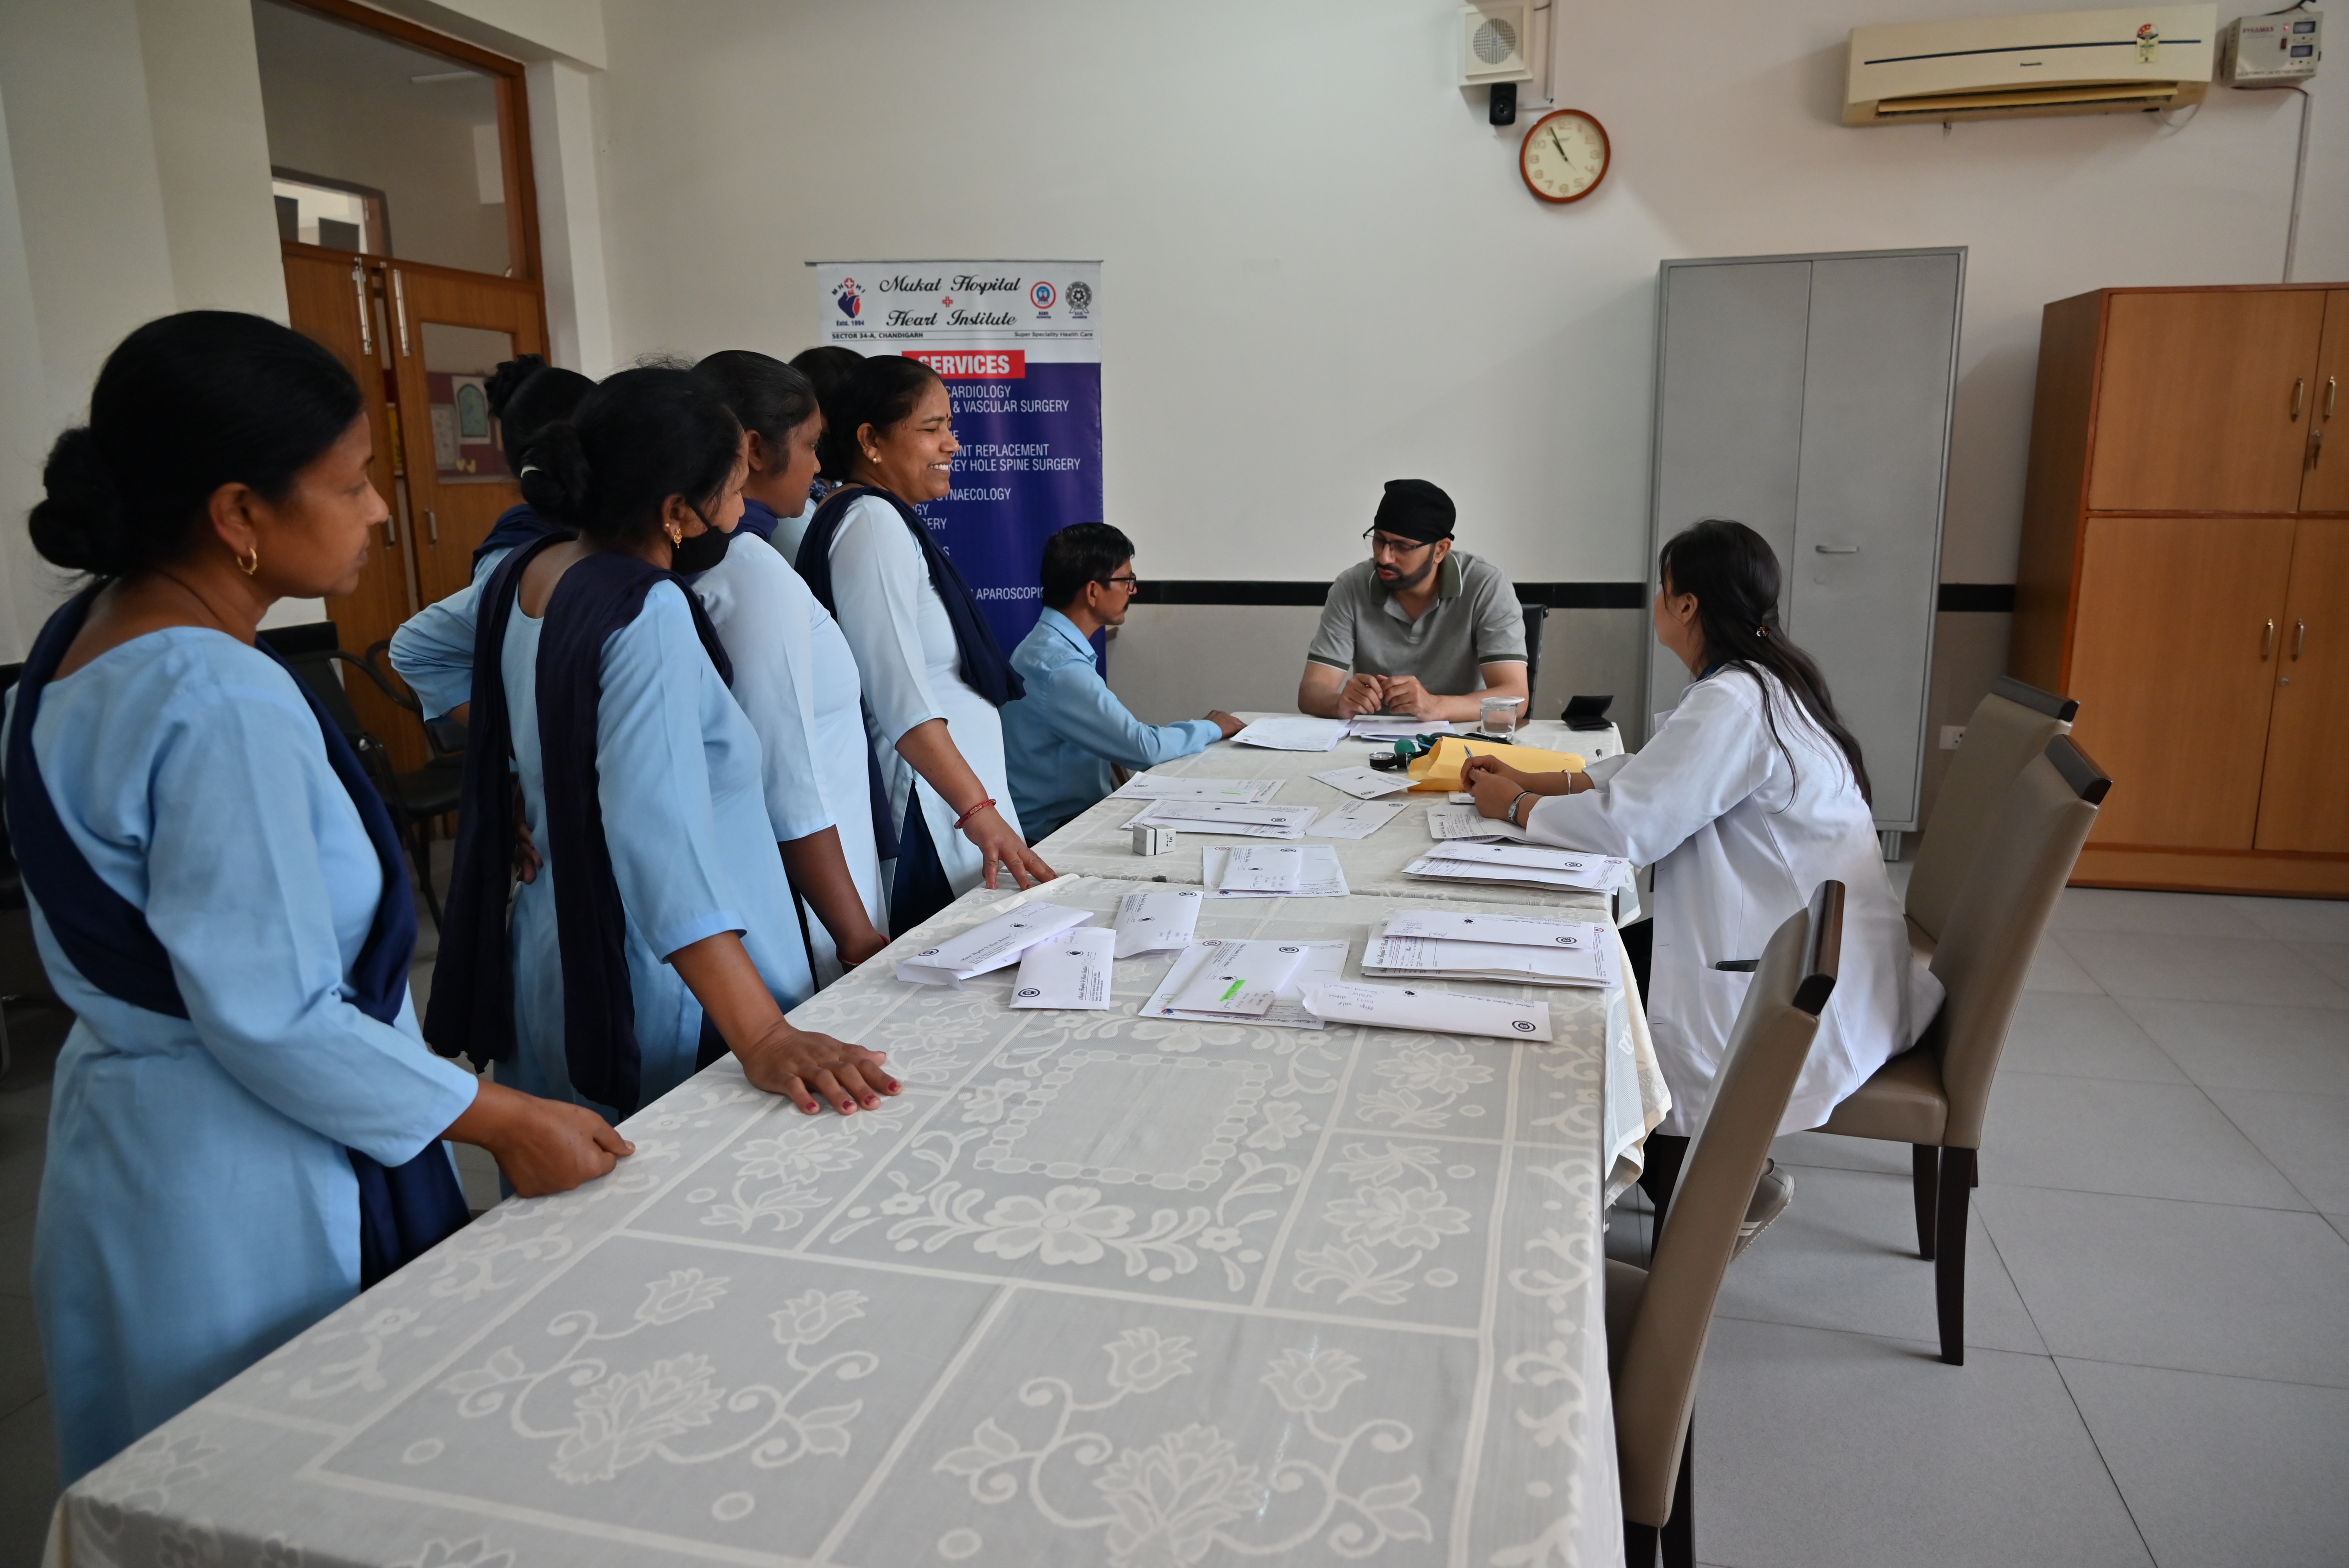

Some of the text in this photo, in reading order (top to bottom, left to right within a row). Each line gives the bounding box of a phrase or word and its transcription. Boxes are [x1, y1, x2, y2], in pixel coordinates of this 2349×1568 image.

[879, 274, 1021, 295] Mukat Hospital
[886, 309, 1017, 326] Heart Institute
[953, 399, 1069, 413] & VASCULAR SURGERY
[976, 444, 1049, 457] REPLACEMENT
[970, 459, 996, 471] HOLE
[1000, 458, 1030, 471] SPINE
[1032, 458, 1081, 471] SURGERY
